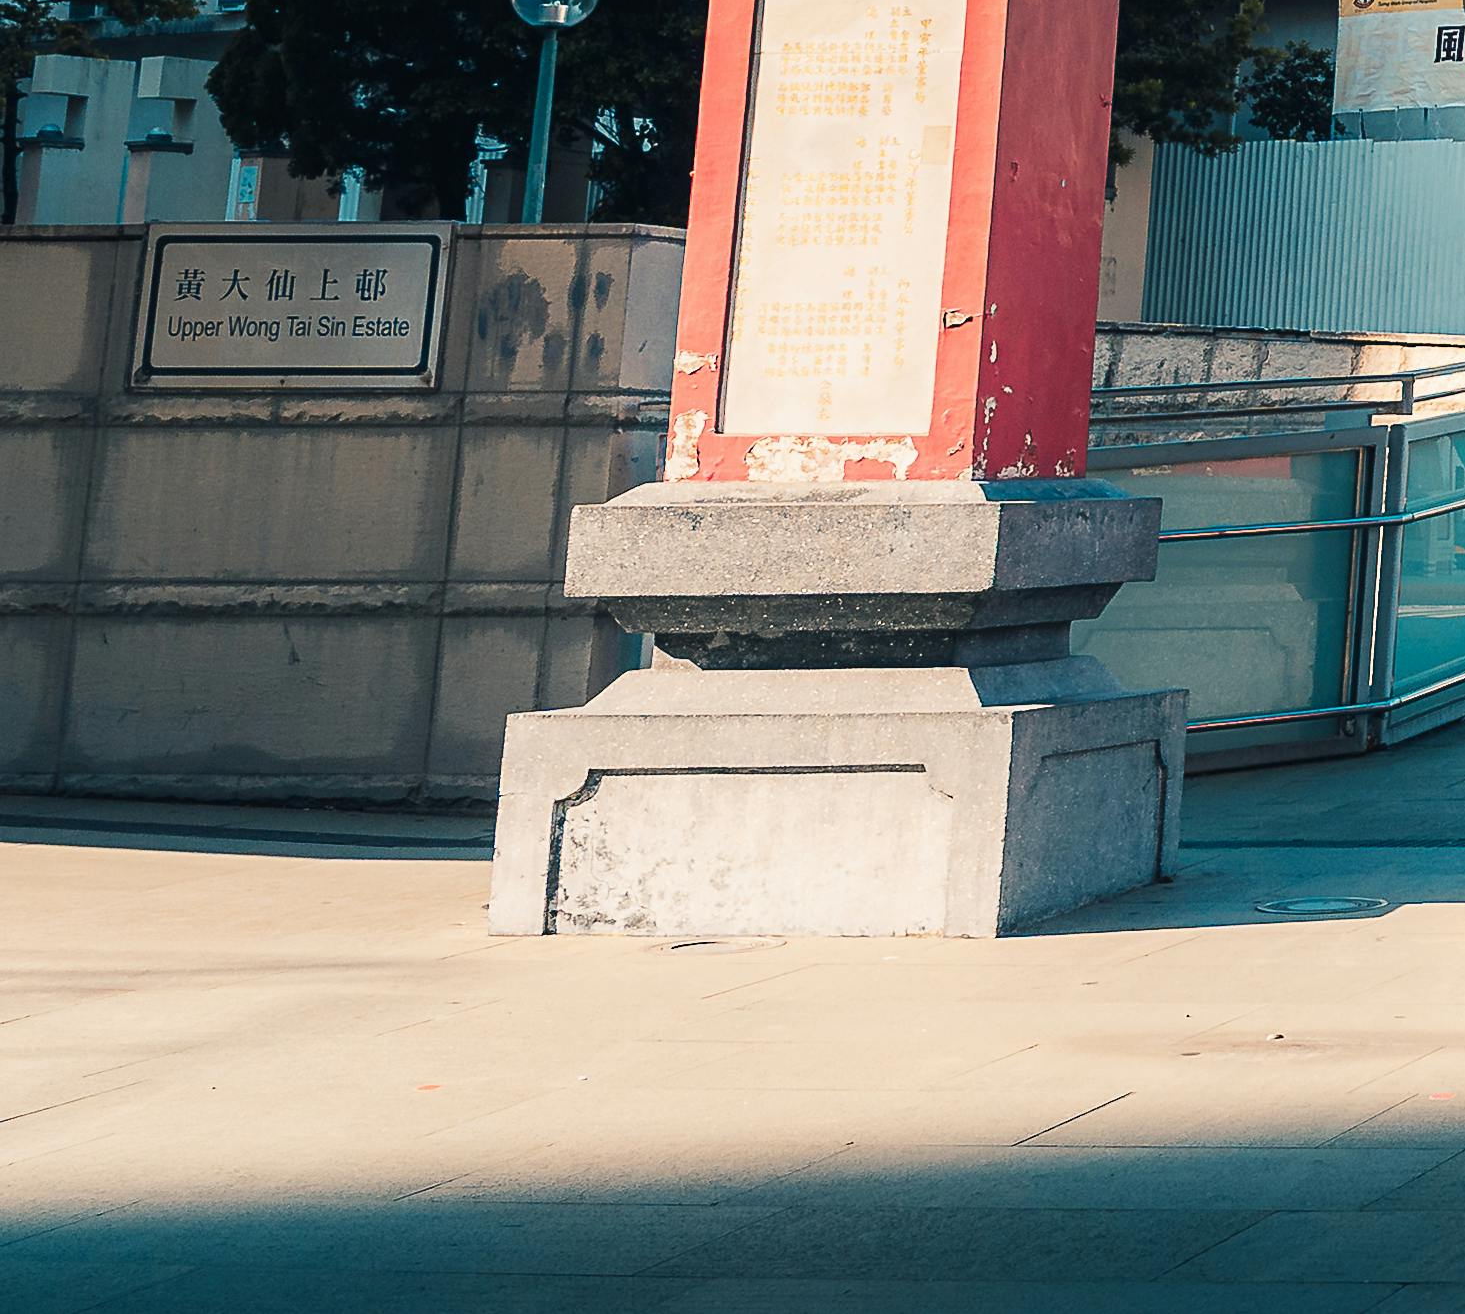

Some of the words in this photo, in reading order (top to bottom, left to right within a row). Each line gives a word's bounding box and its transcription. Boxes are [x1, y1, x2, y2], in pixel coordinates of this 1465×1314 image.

[174, 268, 389, 303] 黃大仙上邨
[167, 315, 224, 339] Upper
[229, 315, 281, 341] Wong
[286, 315, 313, 338] Tai
[317, 315, 347, 338] Sin
[352, 315, 411, 338] Estate
